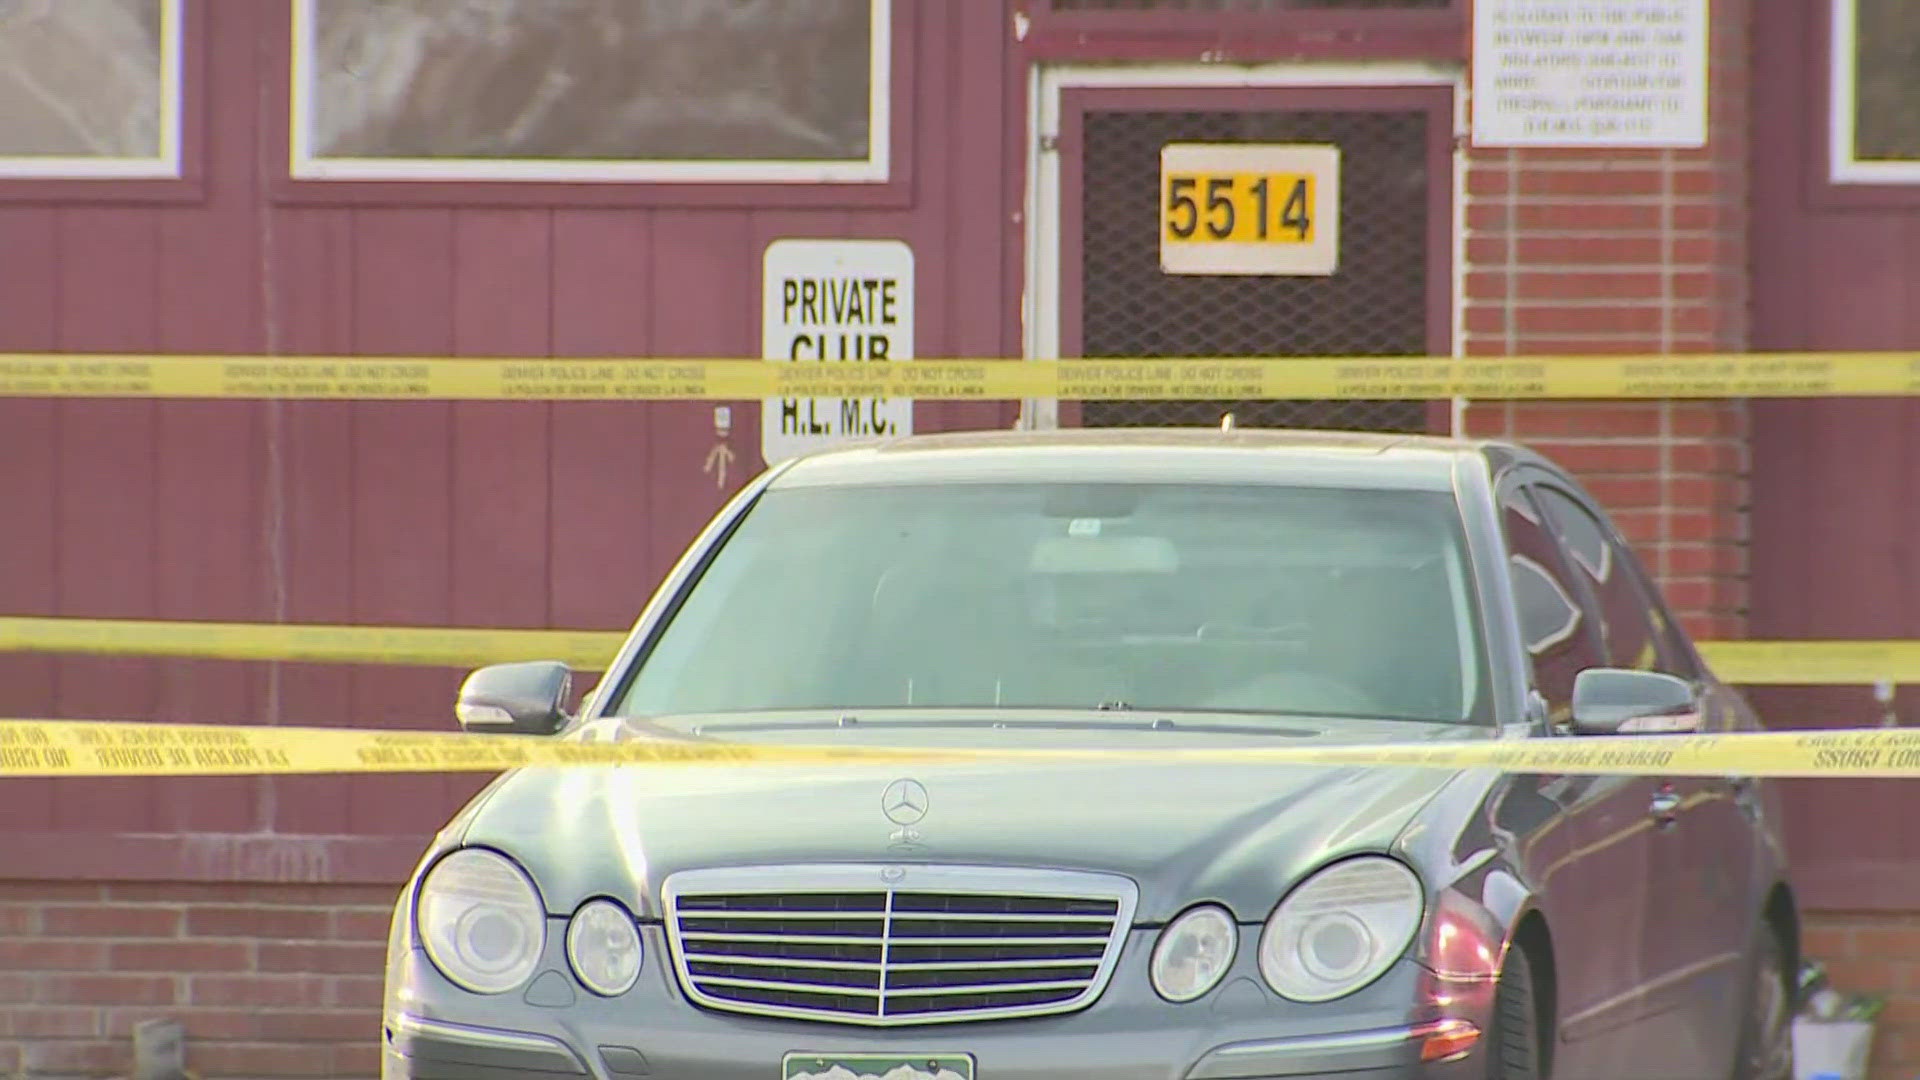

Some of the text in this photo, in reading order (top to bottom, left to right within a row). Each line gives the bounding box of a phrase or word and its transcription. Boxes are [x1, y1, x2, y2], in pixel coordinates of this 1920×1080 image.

[1168, 178, 1310, 240] 5514
[783, 278, 897, 325] PRIVATE
[781, 397, 897, 435] H.L. M.C.
